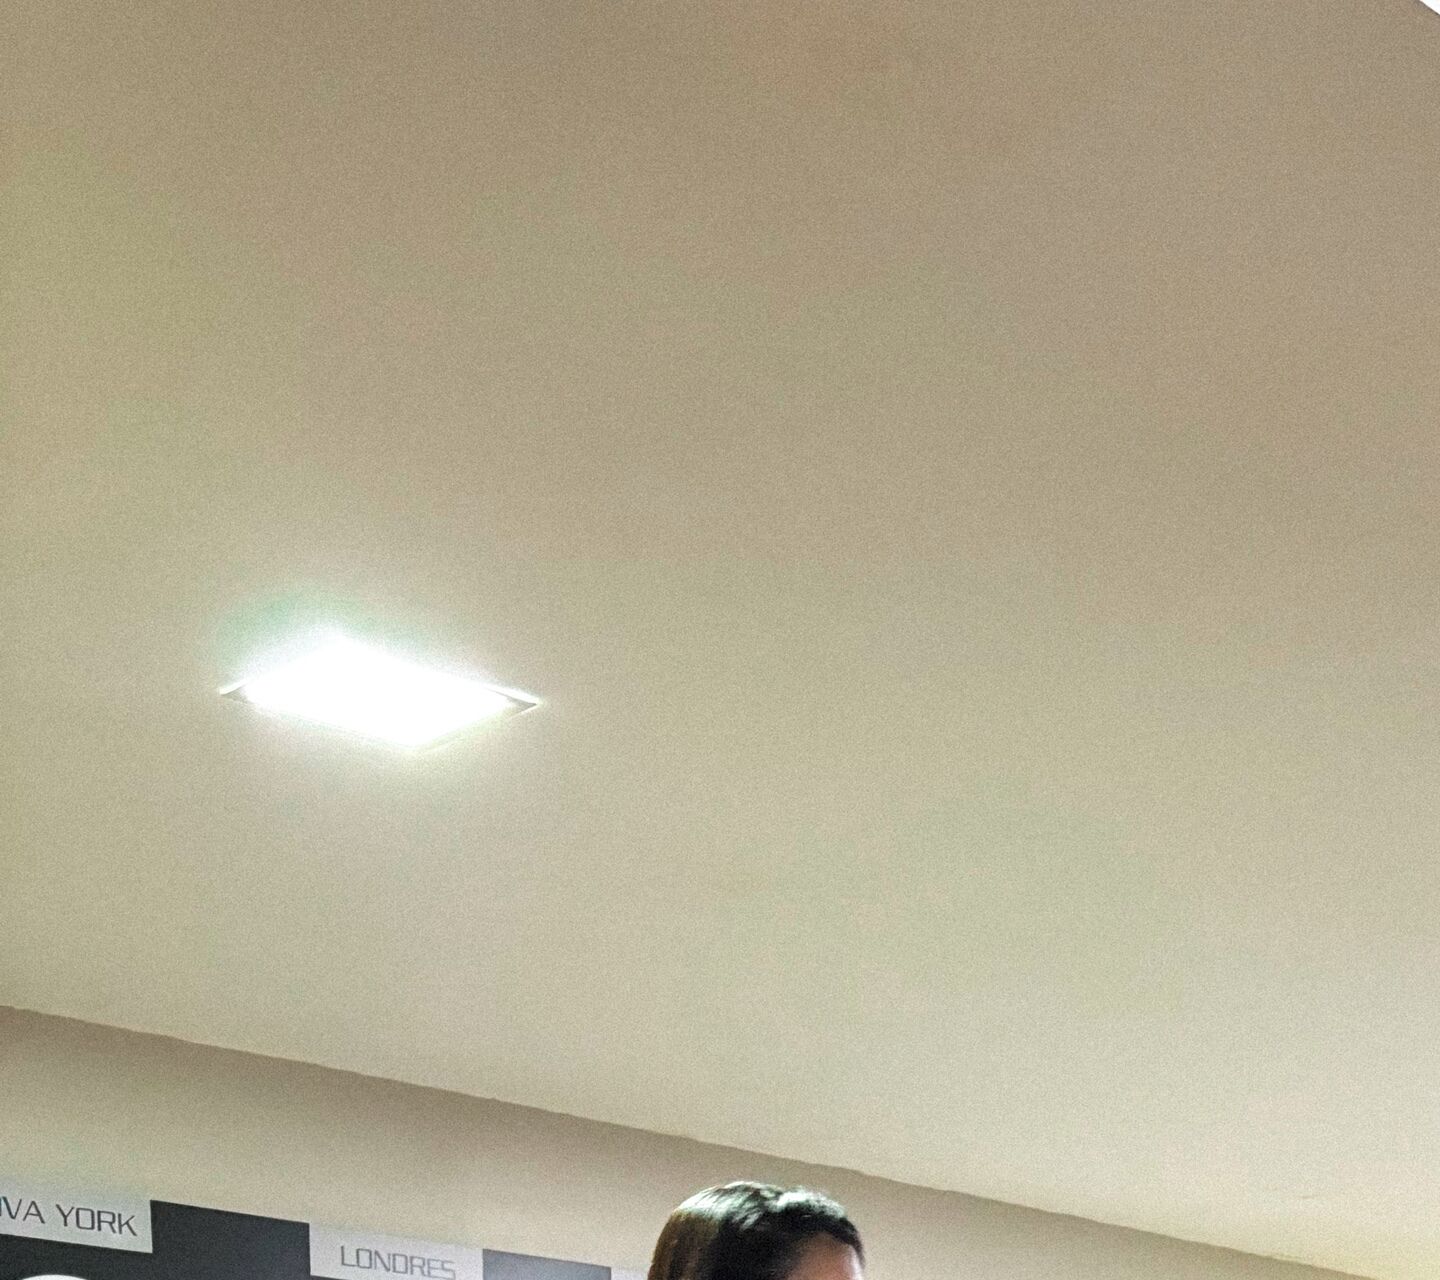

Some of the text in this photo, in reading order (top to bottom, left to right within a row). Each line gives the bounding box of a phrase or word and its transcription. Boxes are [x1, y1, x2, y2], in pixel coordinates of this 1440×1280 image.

[0, 1196, 138, 1237] VA YORK
[340, 1245, 456, 1280] LONDRES
